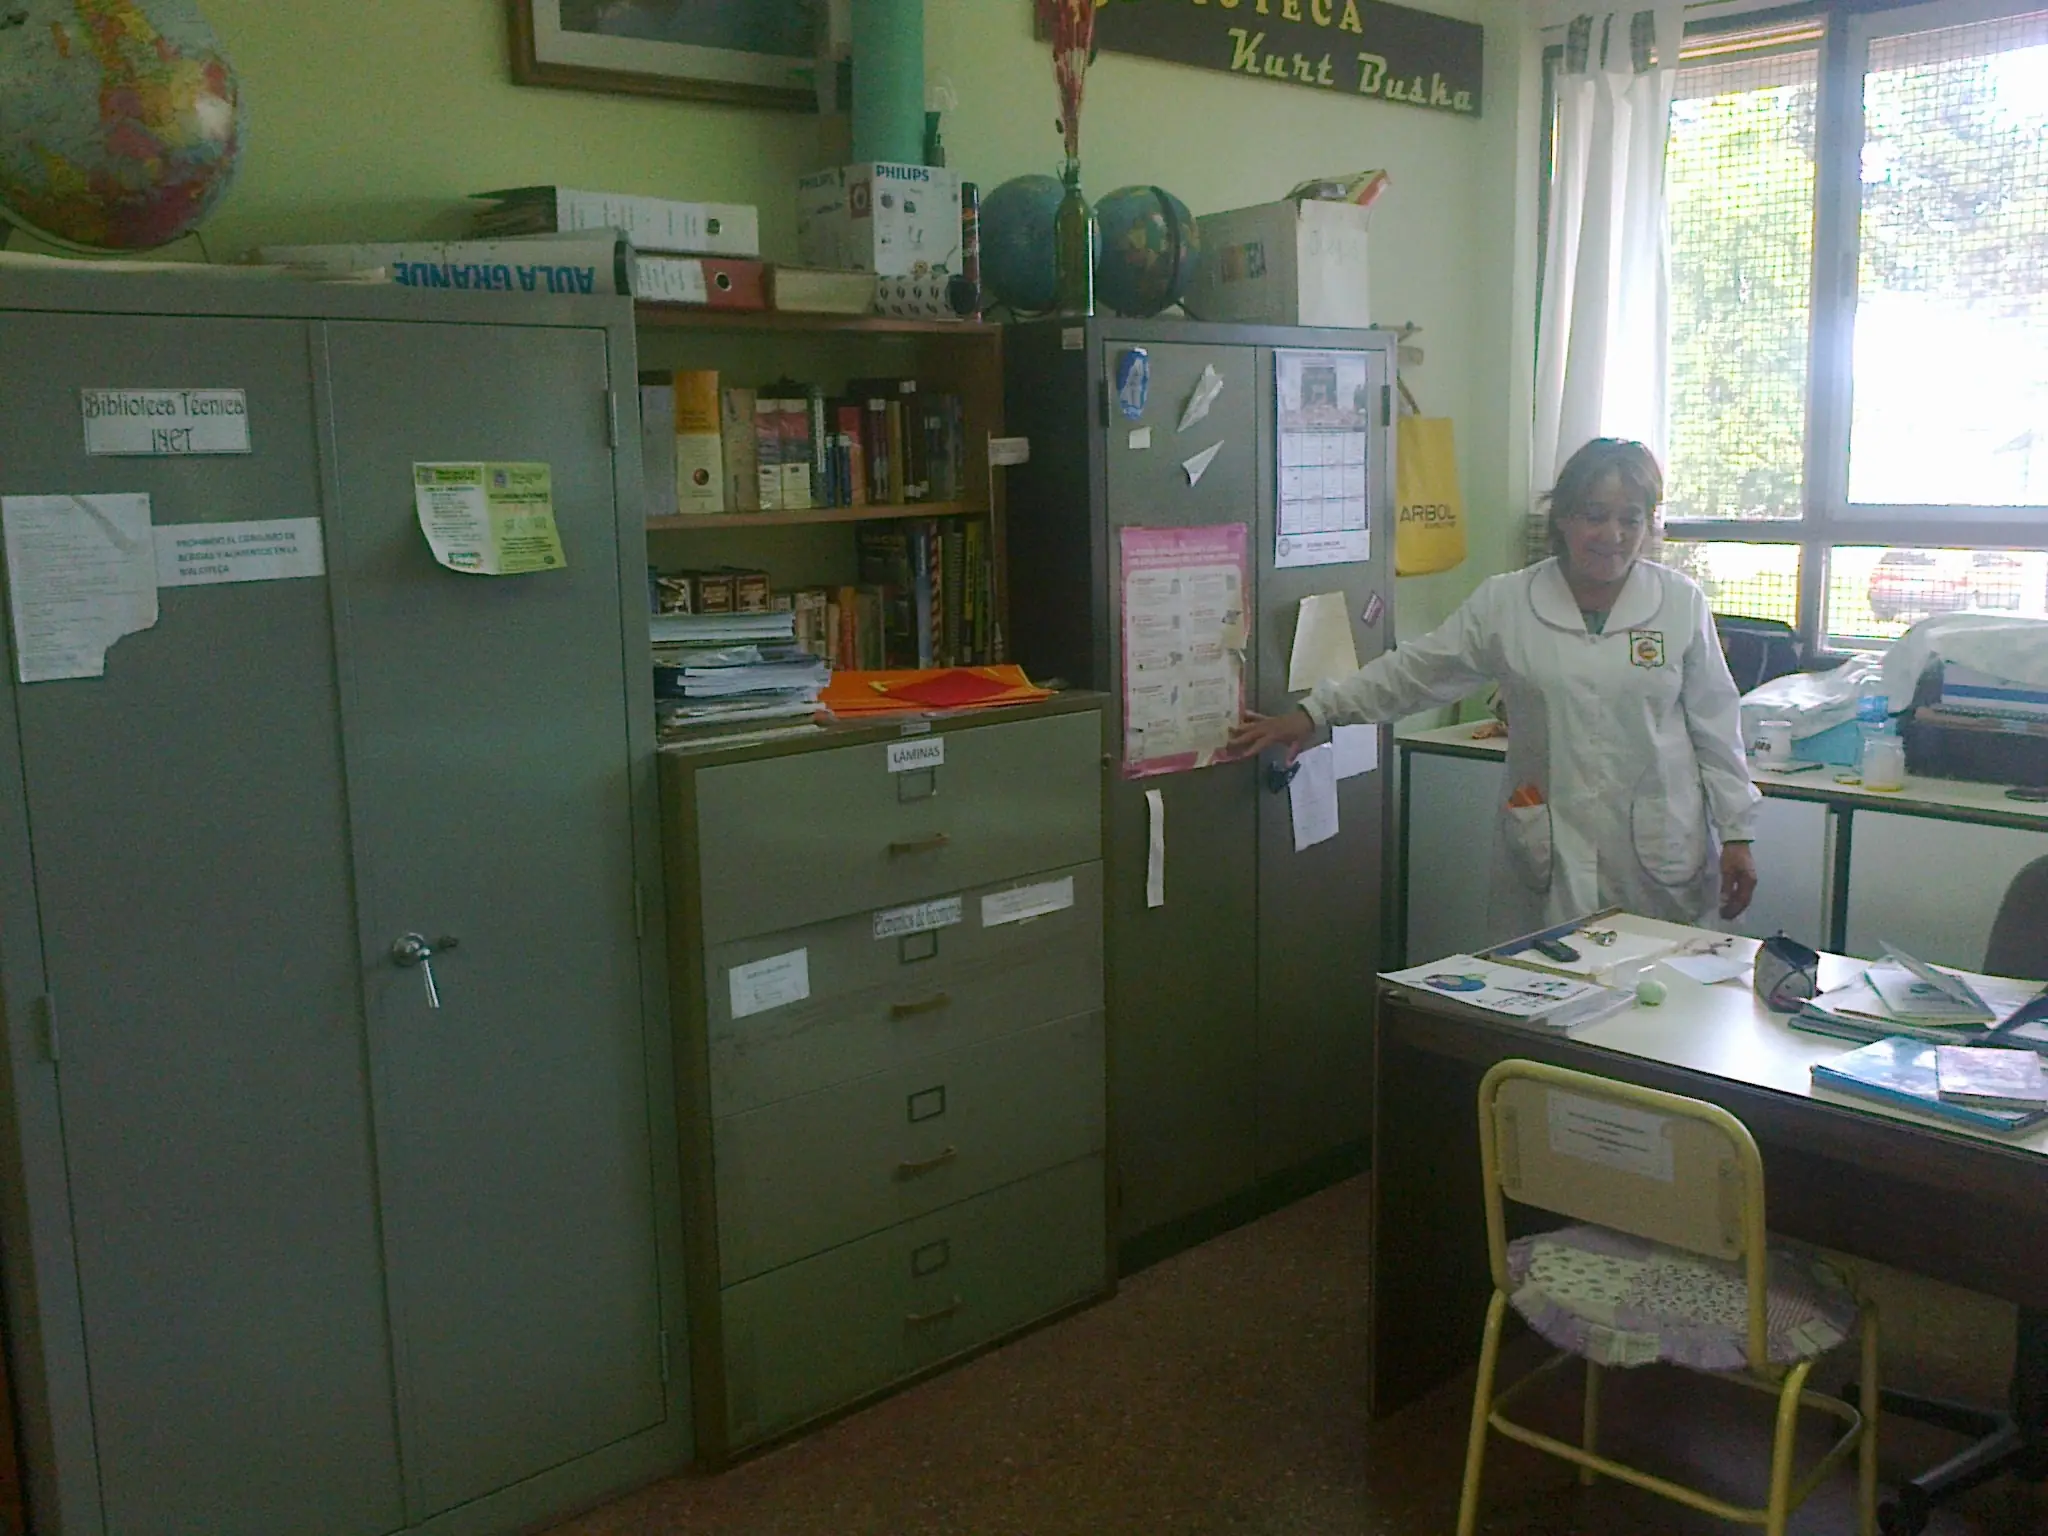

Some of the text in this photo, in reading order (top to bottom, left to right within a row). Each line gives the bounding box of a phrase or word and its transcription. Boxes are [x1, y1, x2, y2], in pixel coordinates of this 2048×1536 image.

[1228, 27, 1474, 112] Kurt Buska
[875, 164, 931, 183] PHILIPS
[515, 264, 597, 295] AULA
[83, 391, 176, 419] Biblioteca
